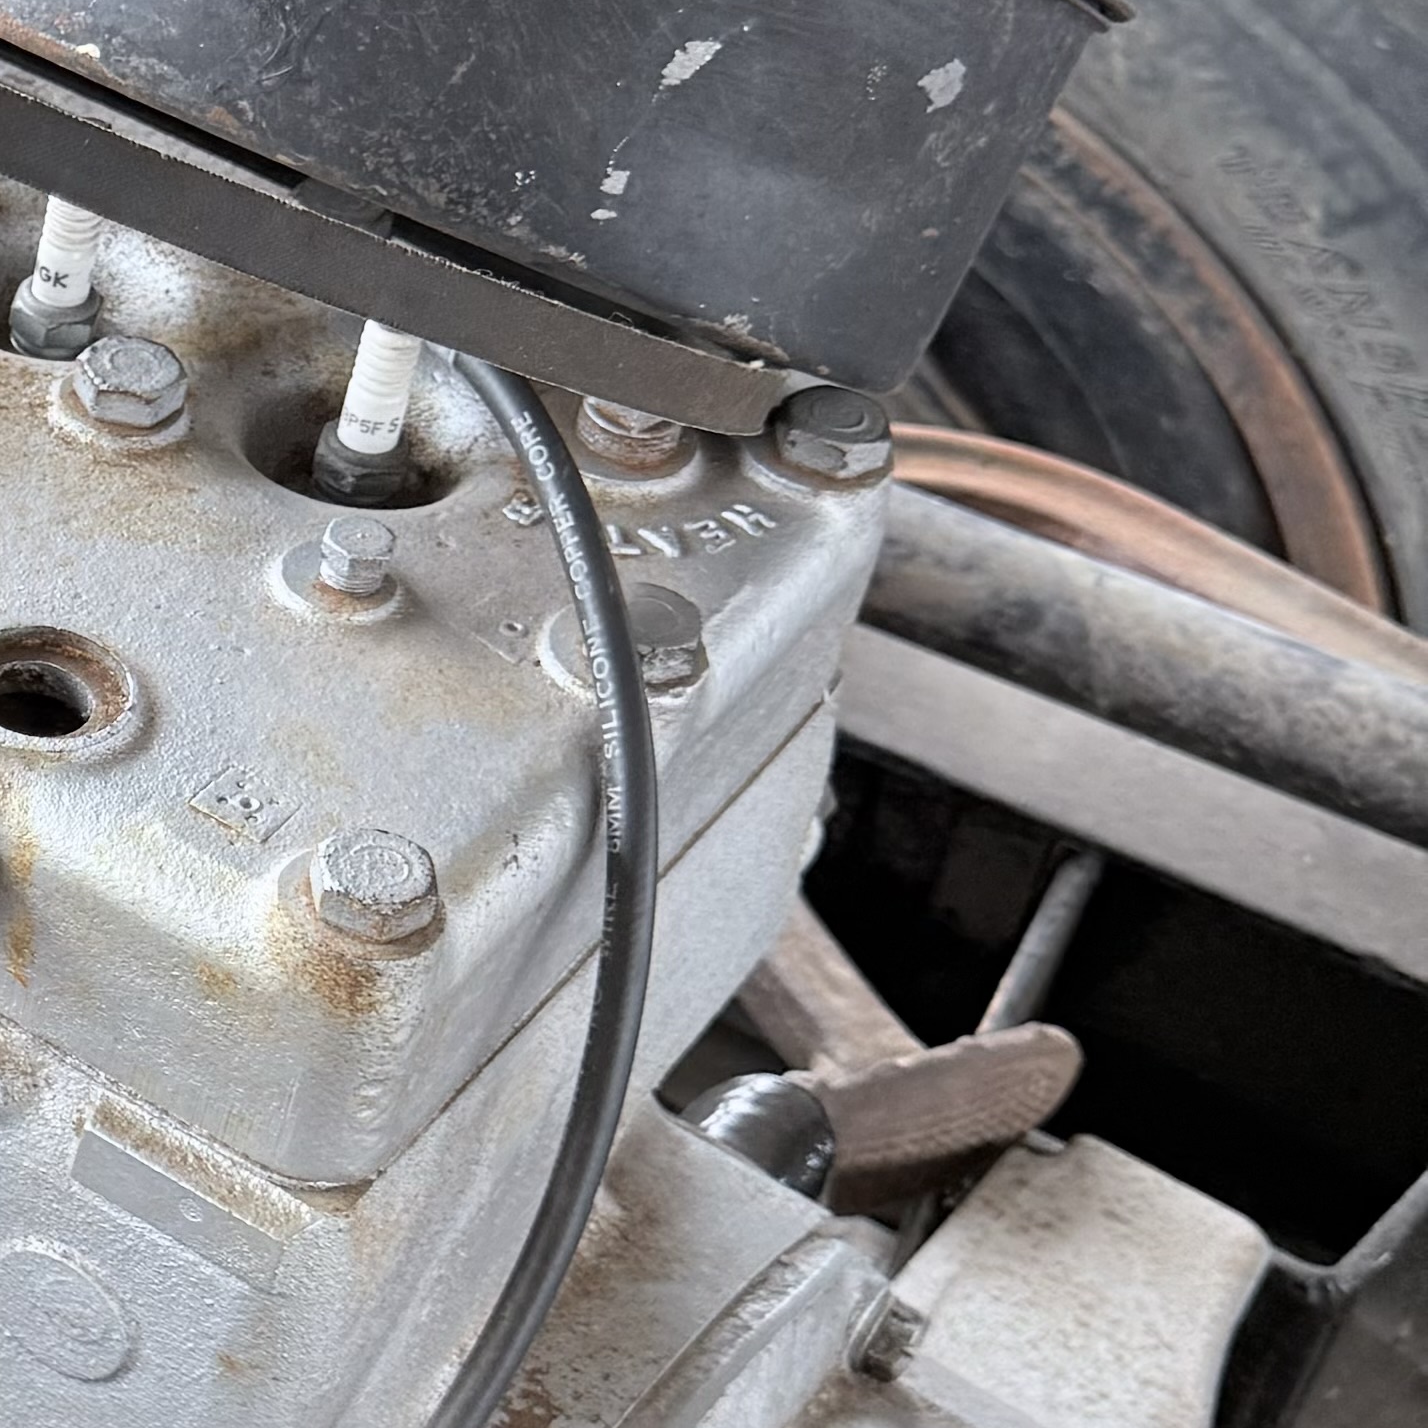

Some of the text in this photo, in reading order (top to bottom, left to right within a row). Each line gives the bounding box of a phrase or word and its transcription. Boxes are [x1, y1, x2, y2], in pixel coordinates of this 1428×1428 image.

[38, 266, 68, 289] GK
[510, 411, 555, 481] CORE
[546, 493, 592, 600] COPPER
[582, 616, 620, 759] SILICONE
